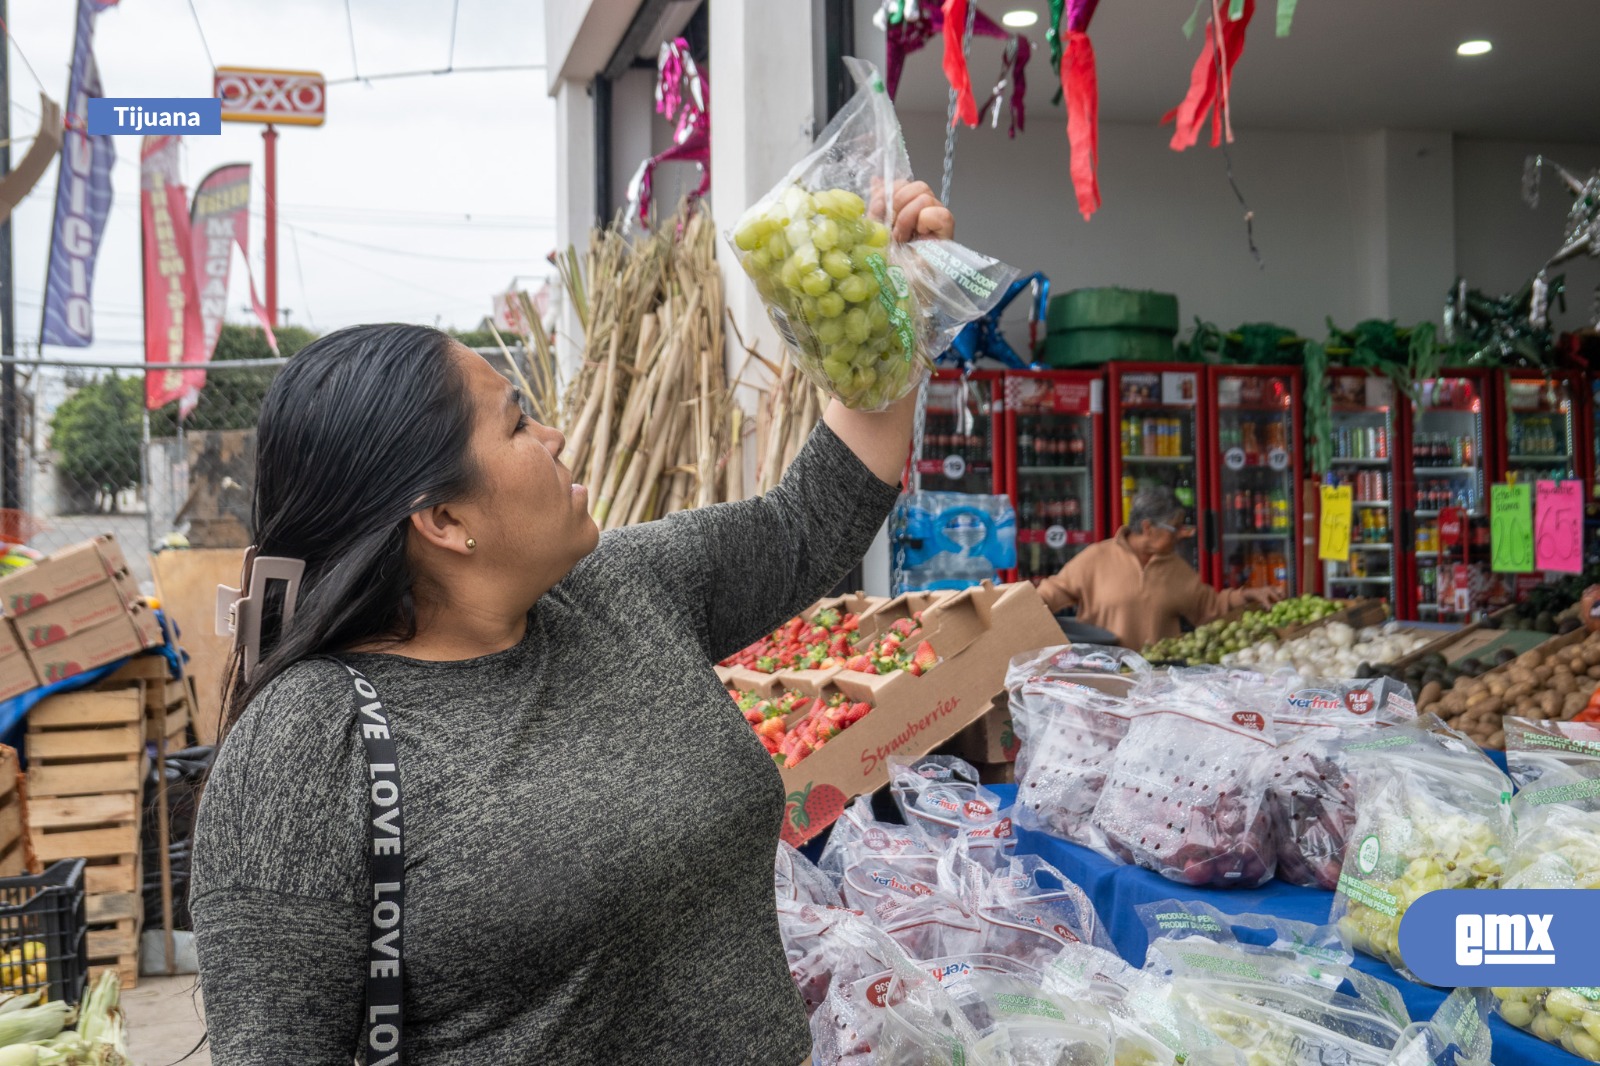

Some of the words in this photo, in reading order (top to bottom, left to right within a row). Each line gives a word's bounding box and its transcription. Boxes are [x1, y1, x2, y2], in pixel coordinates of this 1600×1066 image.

[223, 75, 322, 113] OXXO
[1537, 506, 1574, 561] 65
[1287, 694, 1341, 711] verfrut
[859, 694, 961, 777] Strawberries
[1523, 731, 1571, 745] PRODUCE
[1572, 739, 1586, 748] OF
[1524, 738, 1566, 749] PRODUIT
[1568, 745, 1582, 753] DU
[1524, 785, 1573, 800] PRODUCE
[1575, 780, 1589, 790] OF
[1529, 792, 1574, 805] PRODUIT
[1575, 790, 1590, 799] DU
[369, 762, 401, 856] LOVE
[927, 793, 958, 812] verfrut
[1372, 887, 1397, 905] GRAPES
[371, 882, 401, 979] LOVE
[1159, 920, 1190, 929] PRODUIT
